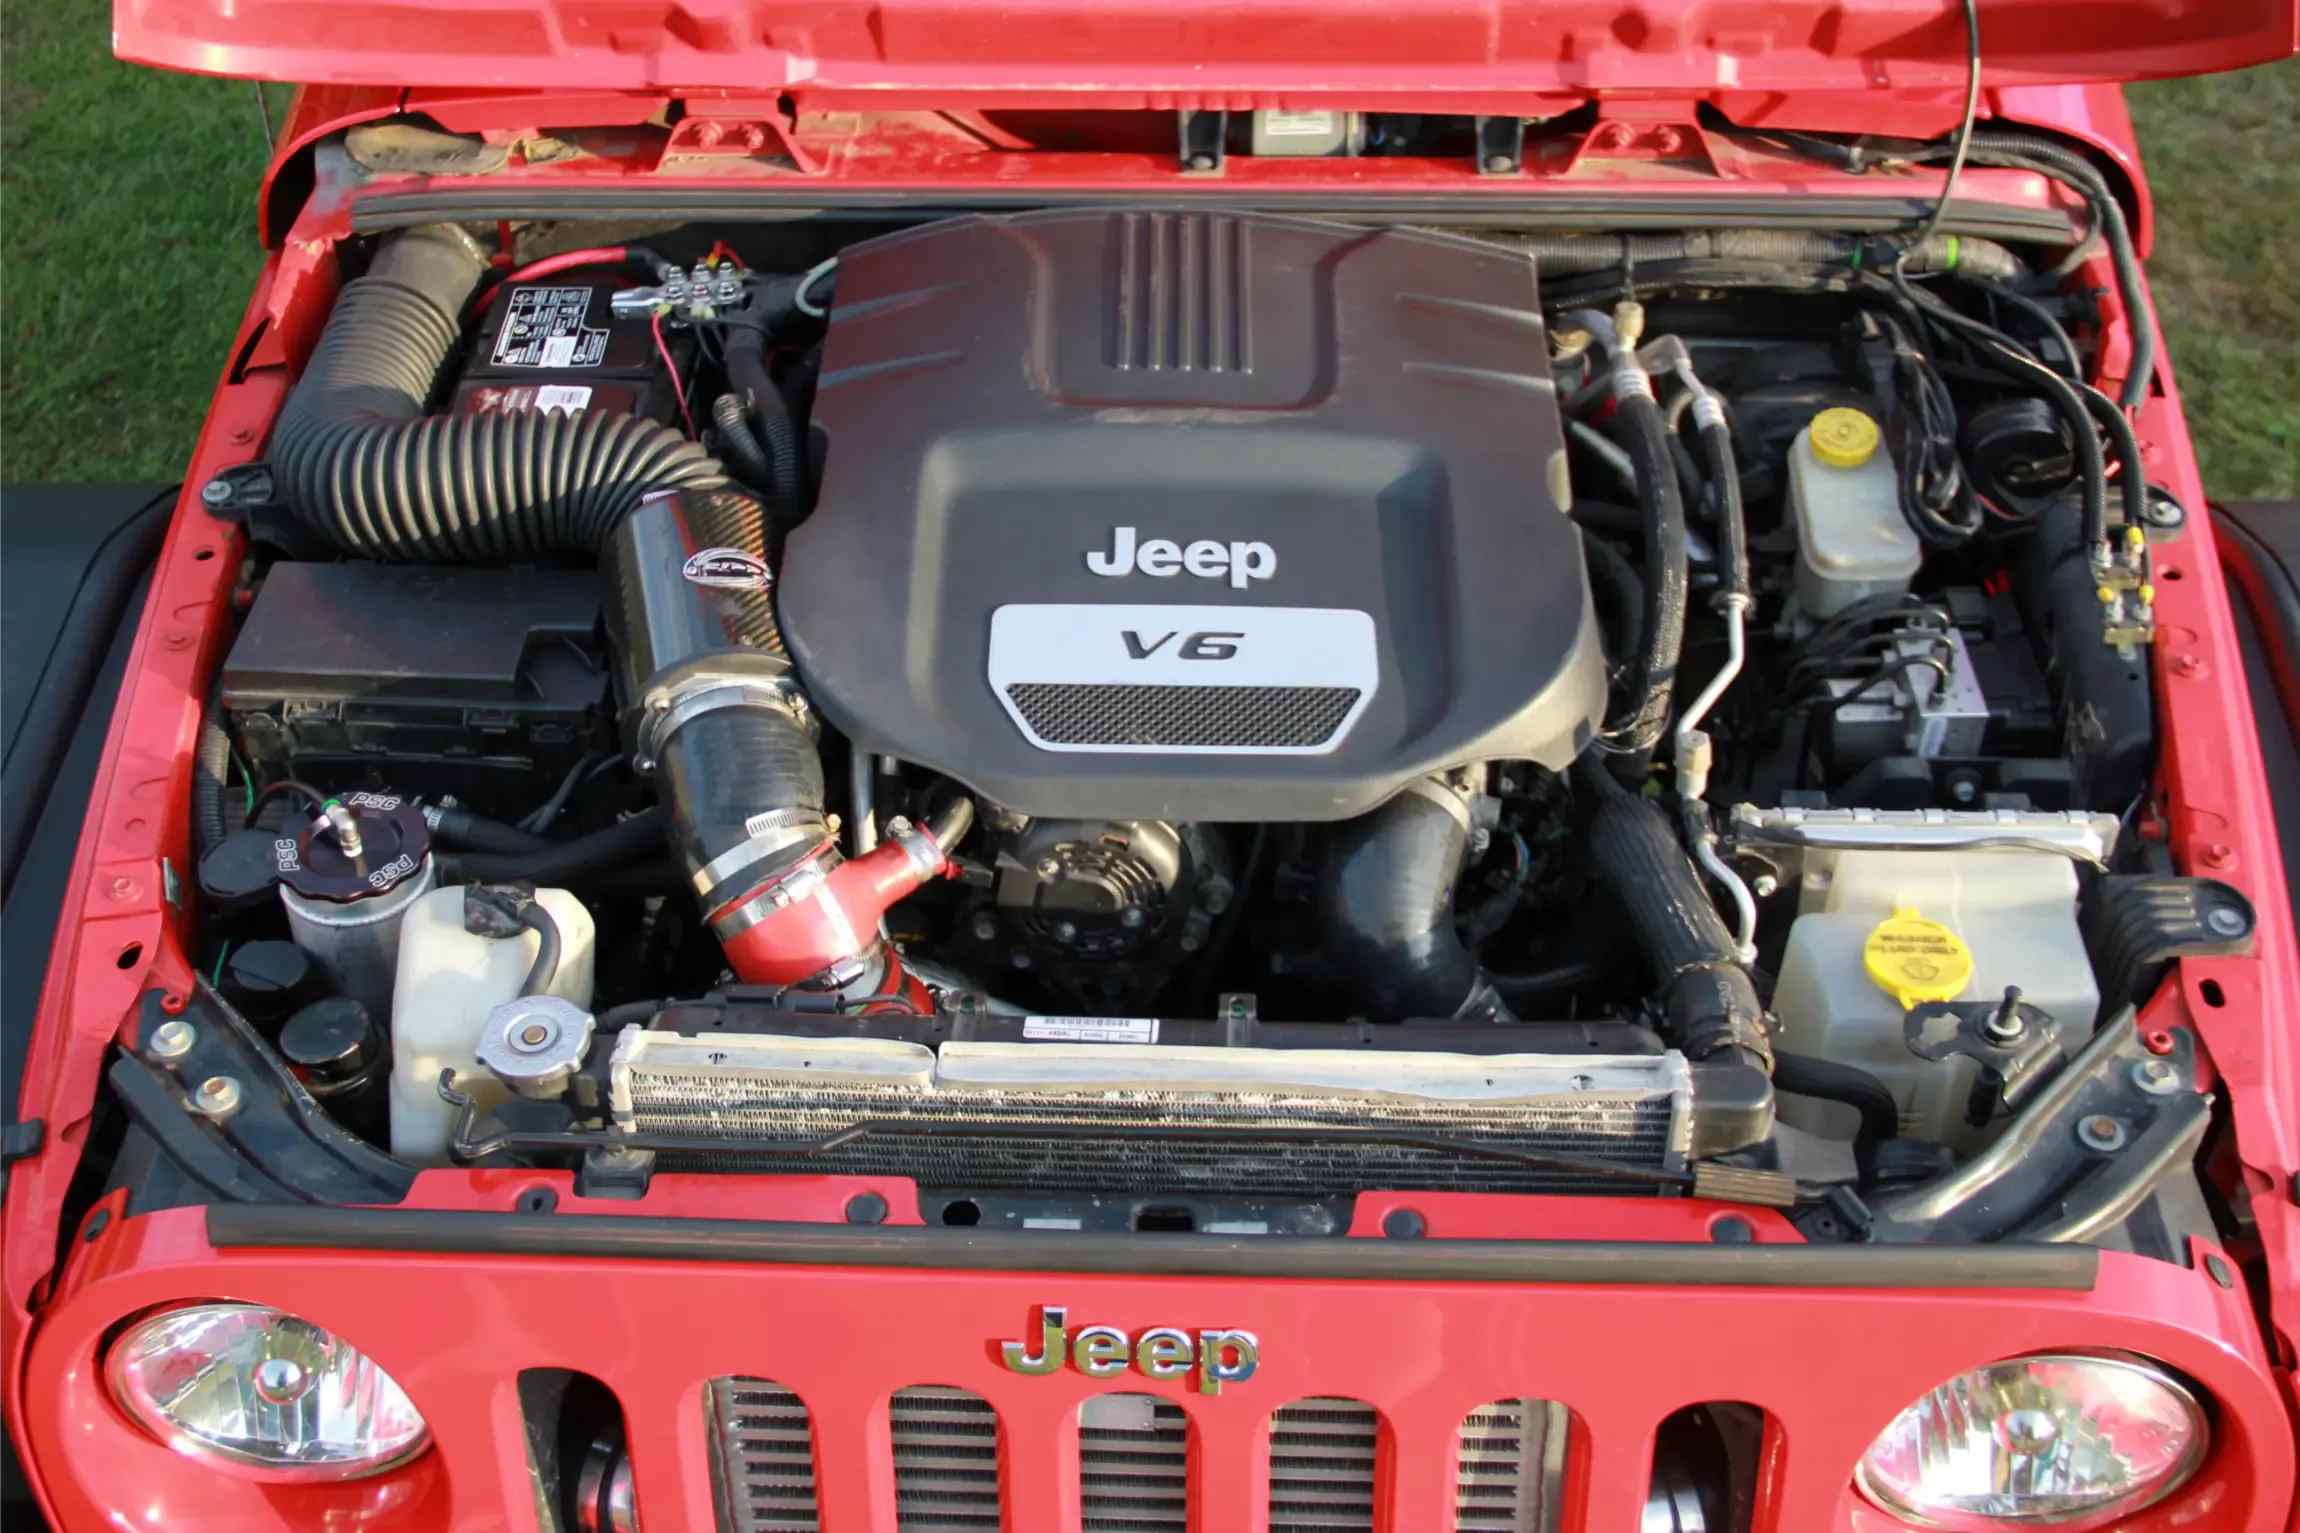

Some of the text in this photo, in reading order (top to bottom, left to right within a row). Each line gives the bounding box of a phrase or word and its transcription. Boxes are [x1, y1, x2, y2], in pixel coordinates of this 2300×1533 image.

[1087, 527, 1277, 588] Jeep
[1121, 630, 1245, 660] V6
[350, 792, 401, 811] PSC
[275, 838, 300, 871] PSC
[368, 853, 414, 887] PSC
[1000, 1305, 1260, 1396] Jeep
